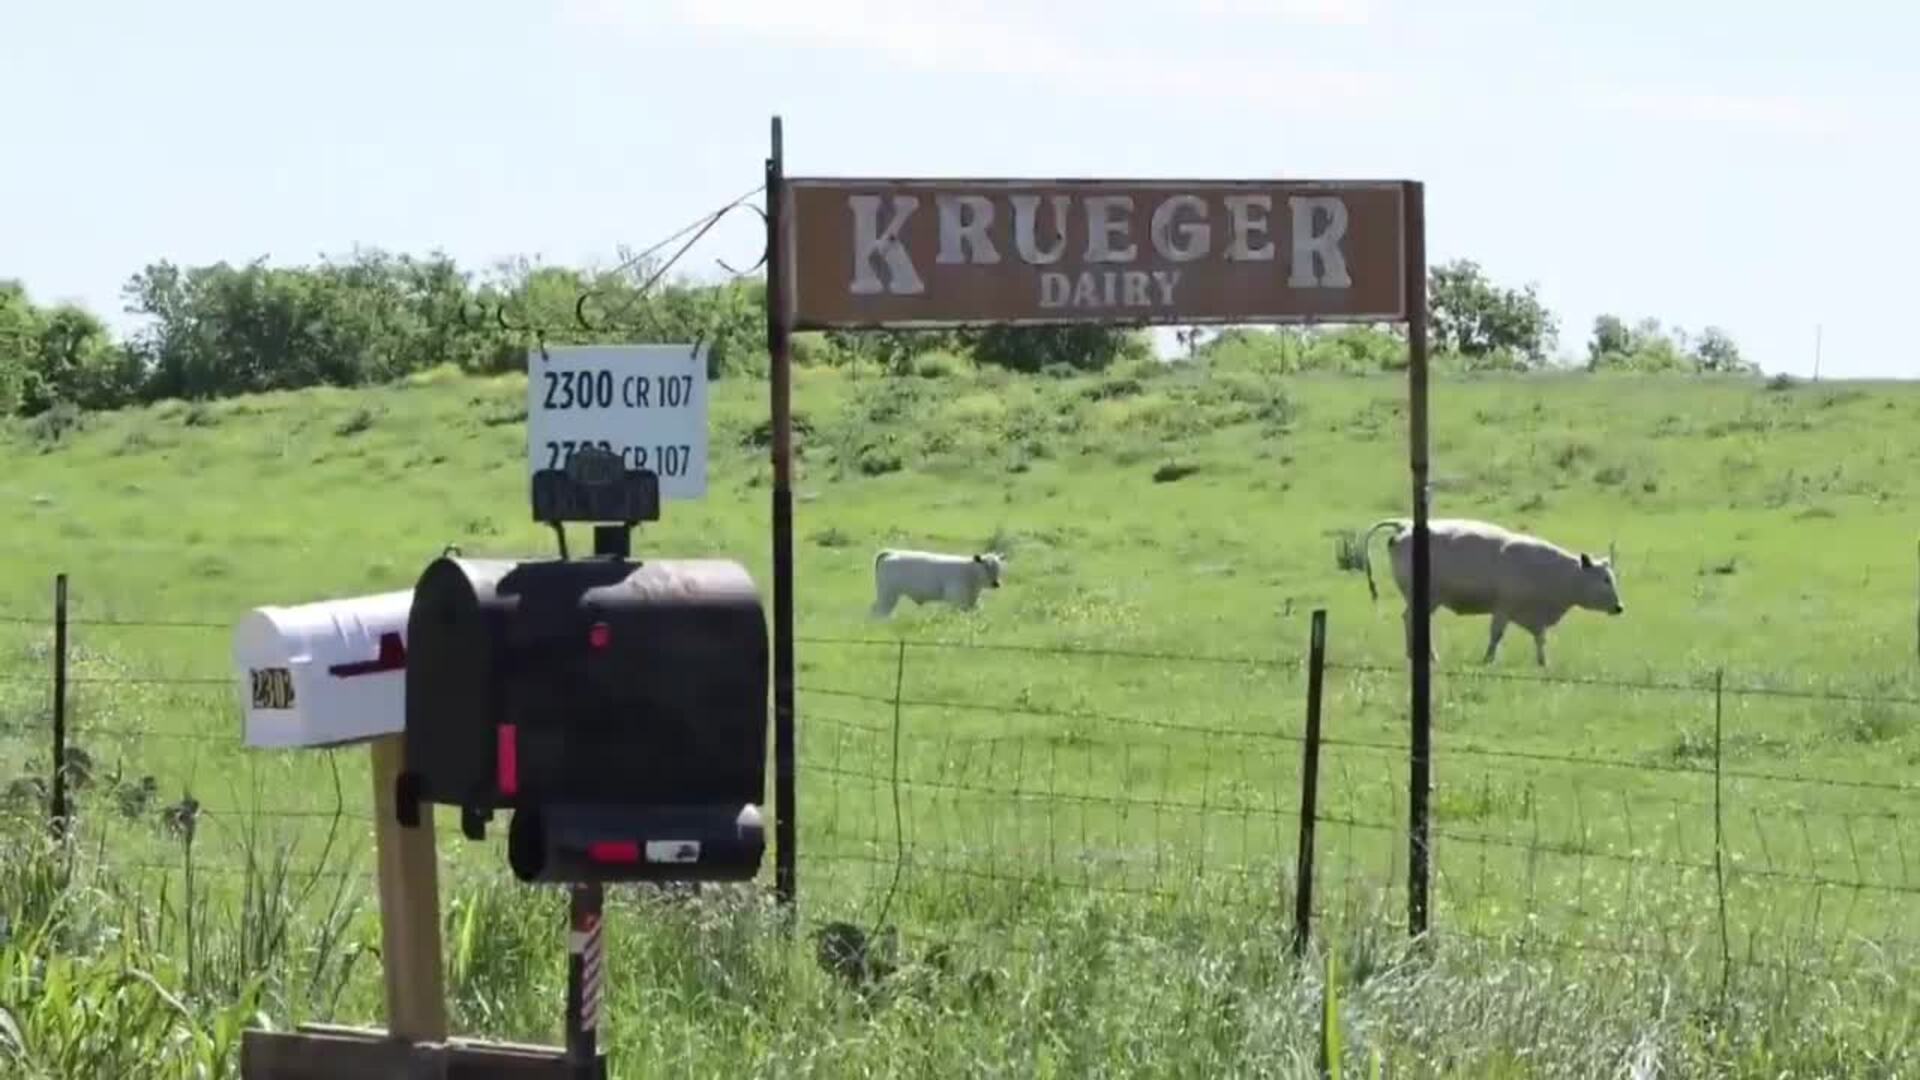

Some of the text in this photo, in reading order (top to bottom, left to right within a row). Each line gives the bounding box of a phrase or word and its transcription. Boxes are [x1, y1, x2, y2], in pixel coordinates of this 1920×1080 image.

[848, 194, 1352, 295] KRUEGER
[1039, 269, 1180, 309] DAIRY
[543, 370, 694, 409] 2300 CR 107
[655, 445, 691, 477] 107
